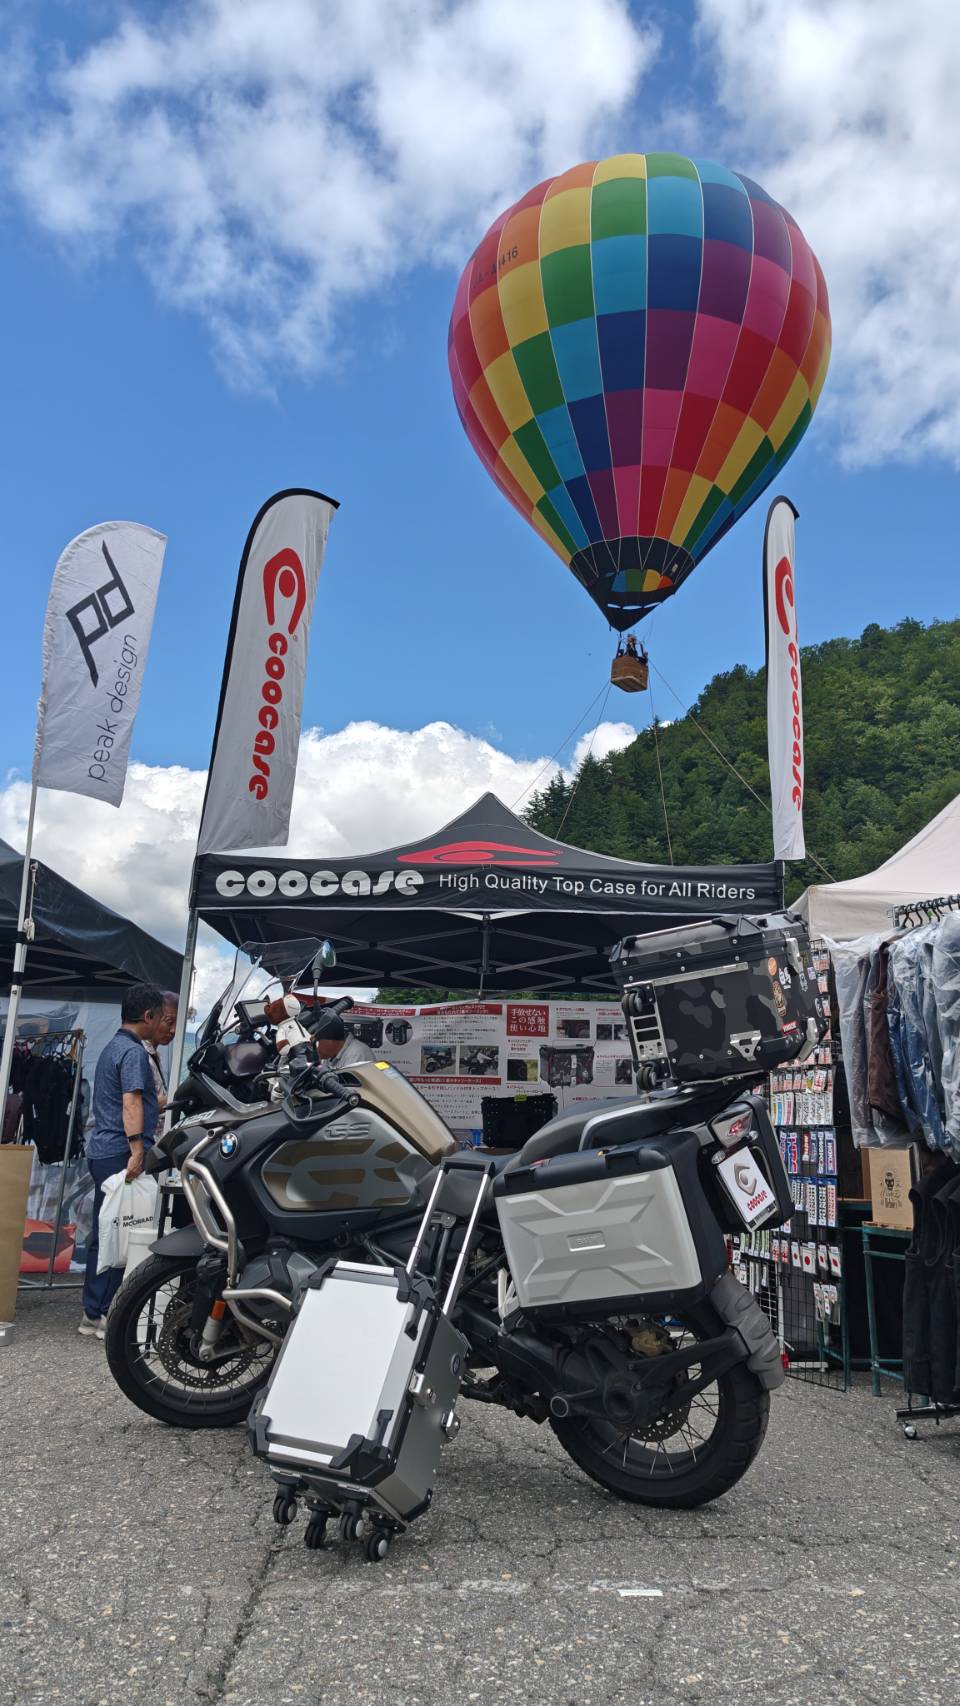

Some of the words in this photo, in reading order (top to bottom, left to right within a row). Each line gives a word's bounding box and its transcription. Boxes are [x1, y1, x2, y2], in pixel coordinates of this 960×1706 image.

[88, 719, 118, 783] peak
[106, 633, 137, 714] design
[439, 874, 479, 892] High
[485, 874, 548, 894] Quality
[552, 876, 585, 895] Top
[590, 879, 636, 895] Case
[641, 880, 665, 896] for
[668, 882, 692, 897] All
[697, 883, 756, 900] Riders
